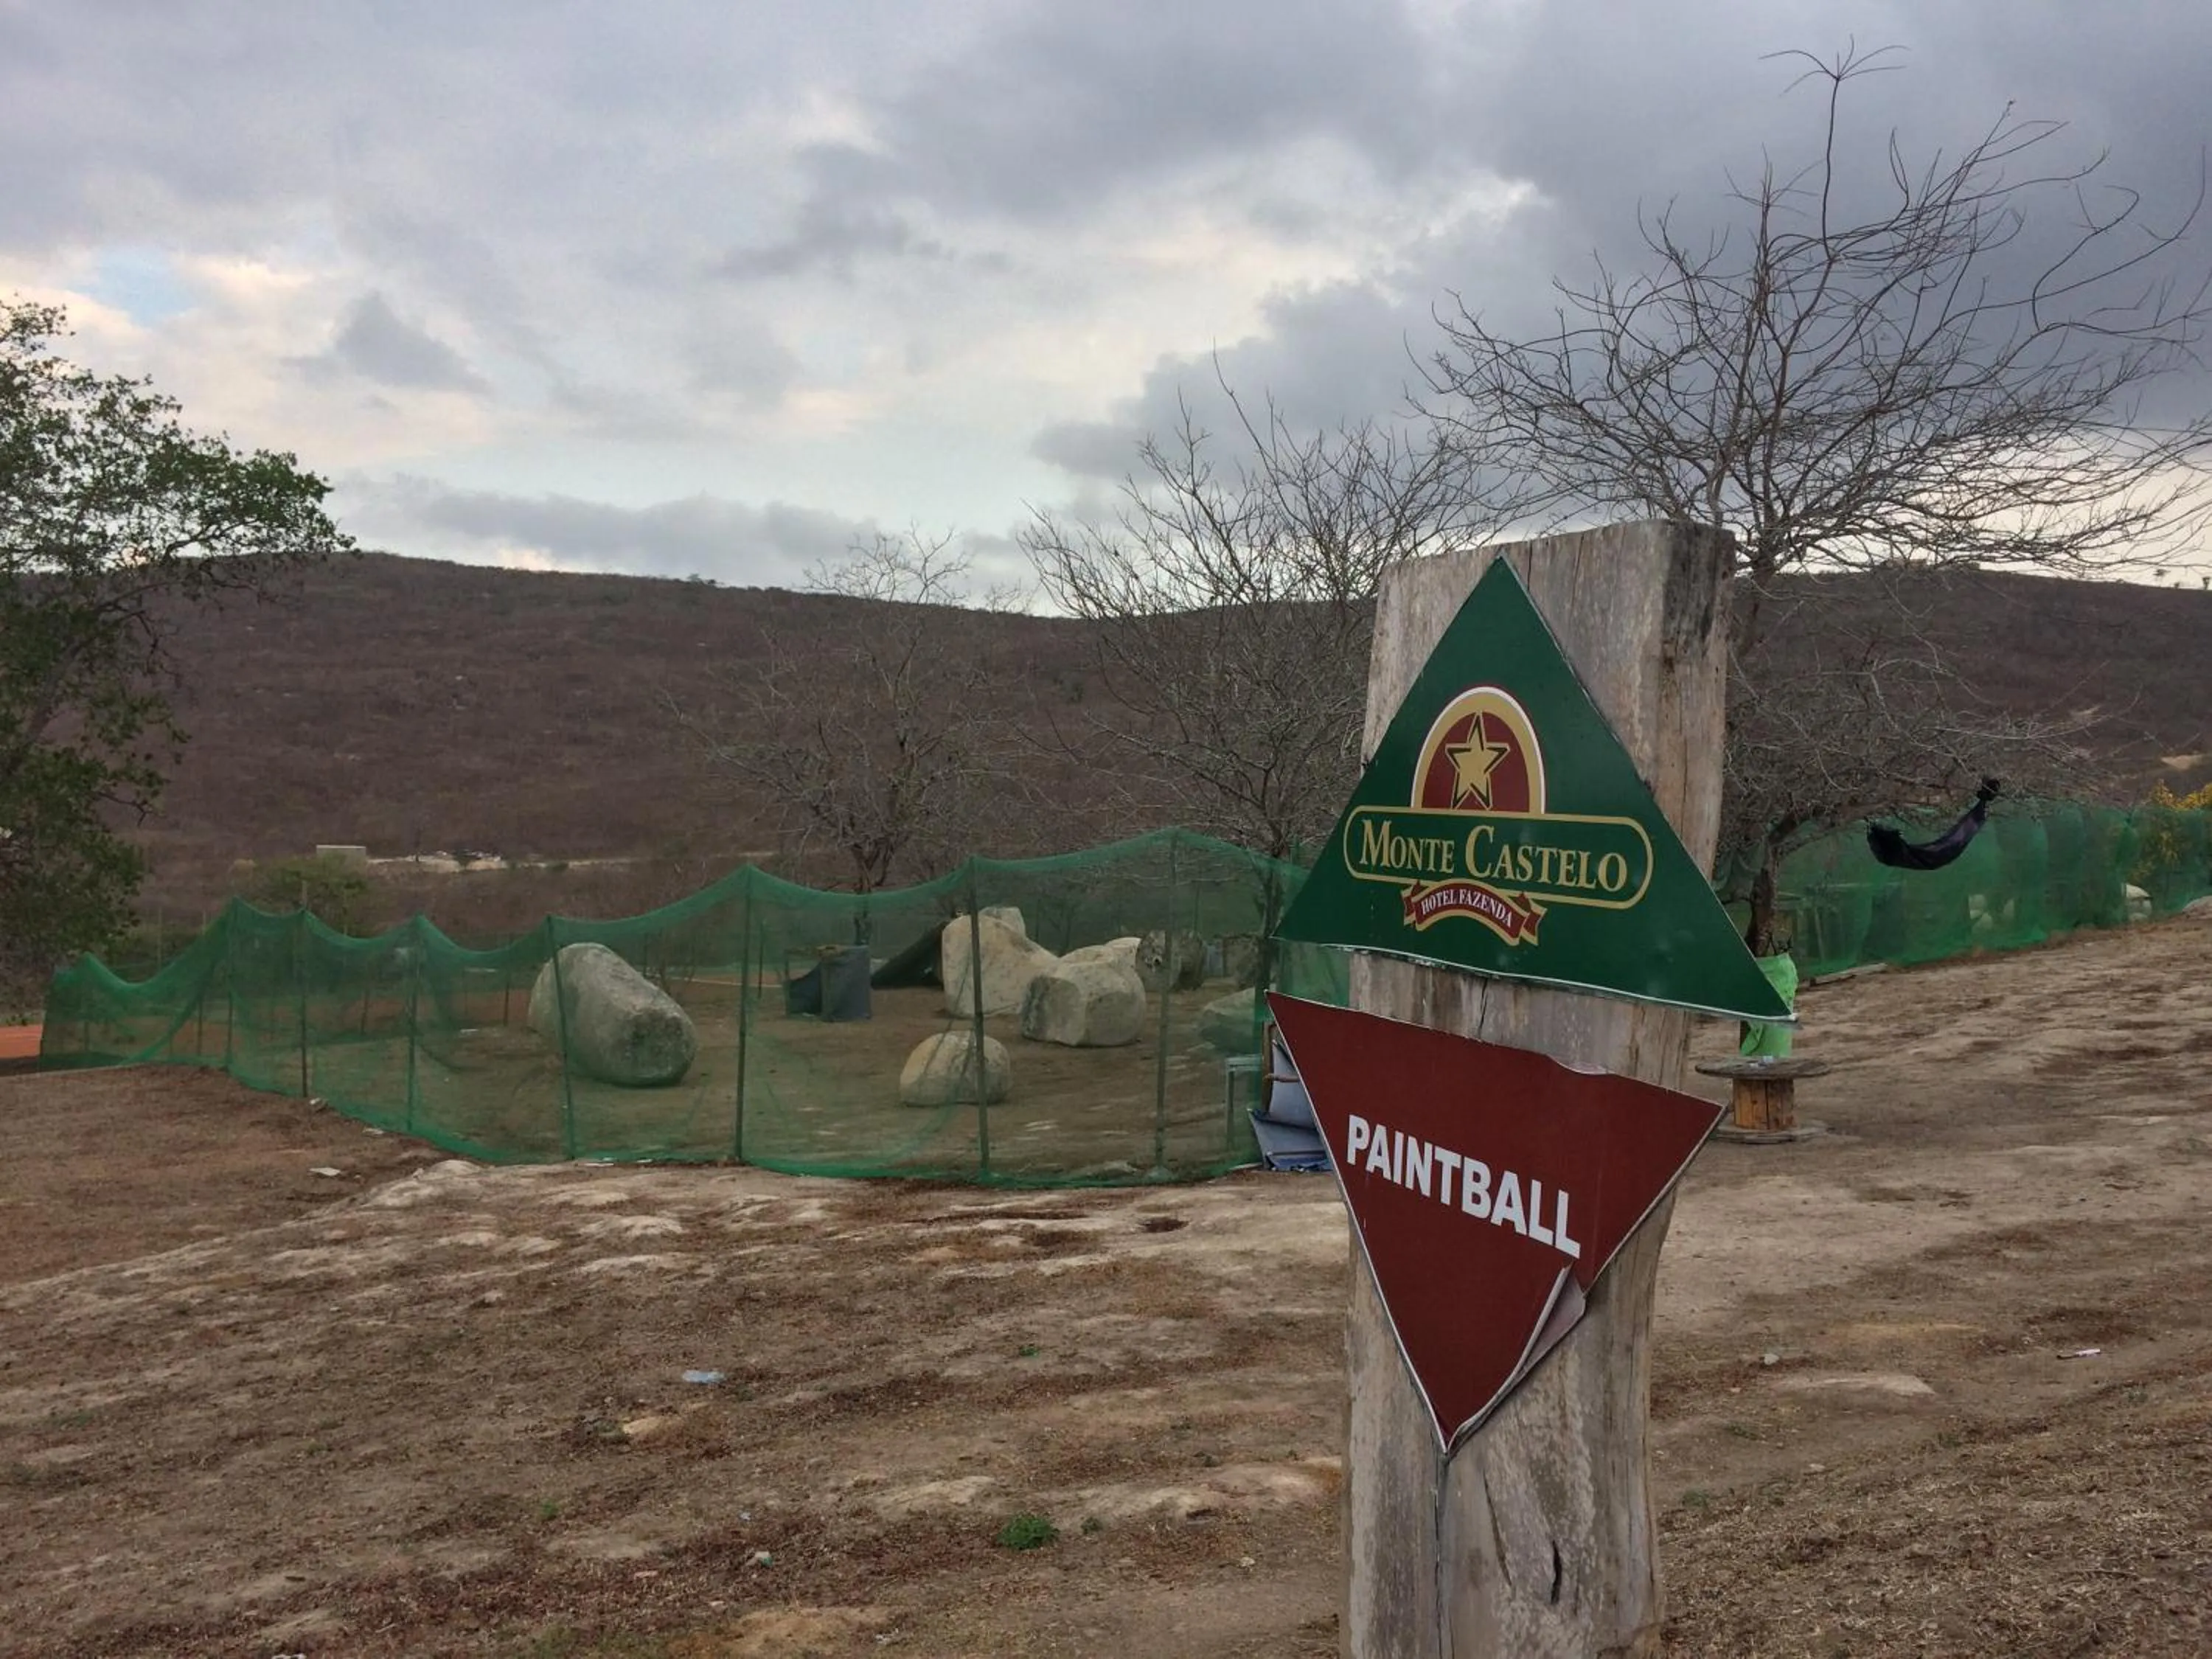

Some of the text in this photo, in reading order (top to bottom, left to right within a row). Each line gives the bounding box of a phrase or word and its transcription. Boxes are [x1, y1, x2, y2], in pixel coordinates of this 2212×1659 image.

[1359, 819, 1628, 892] MONTE CASTELO
[1420, 888, 1512, 928] HOTEL FAZENDA
[1346, 1114, 1581, 1259] PAINTBALL
